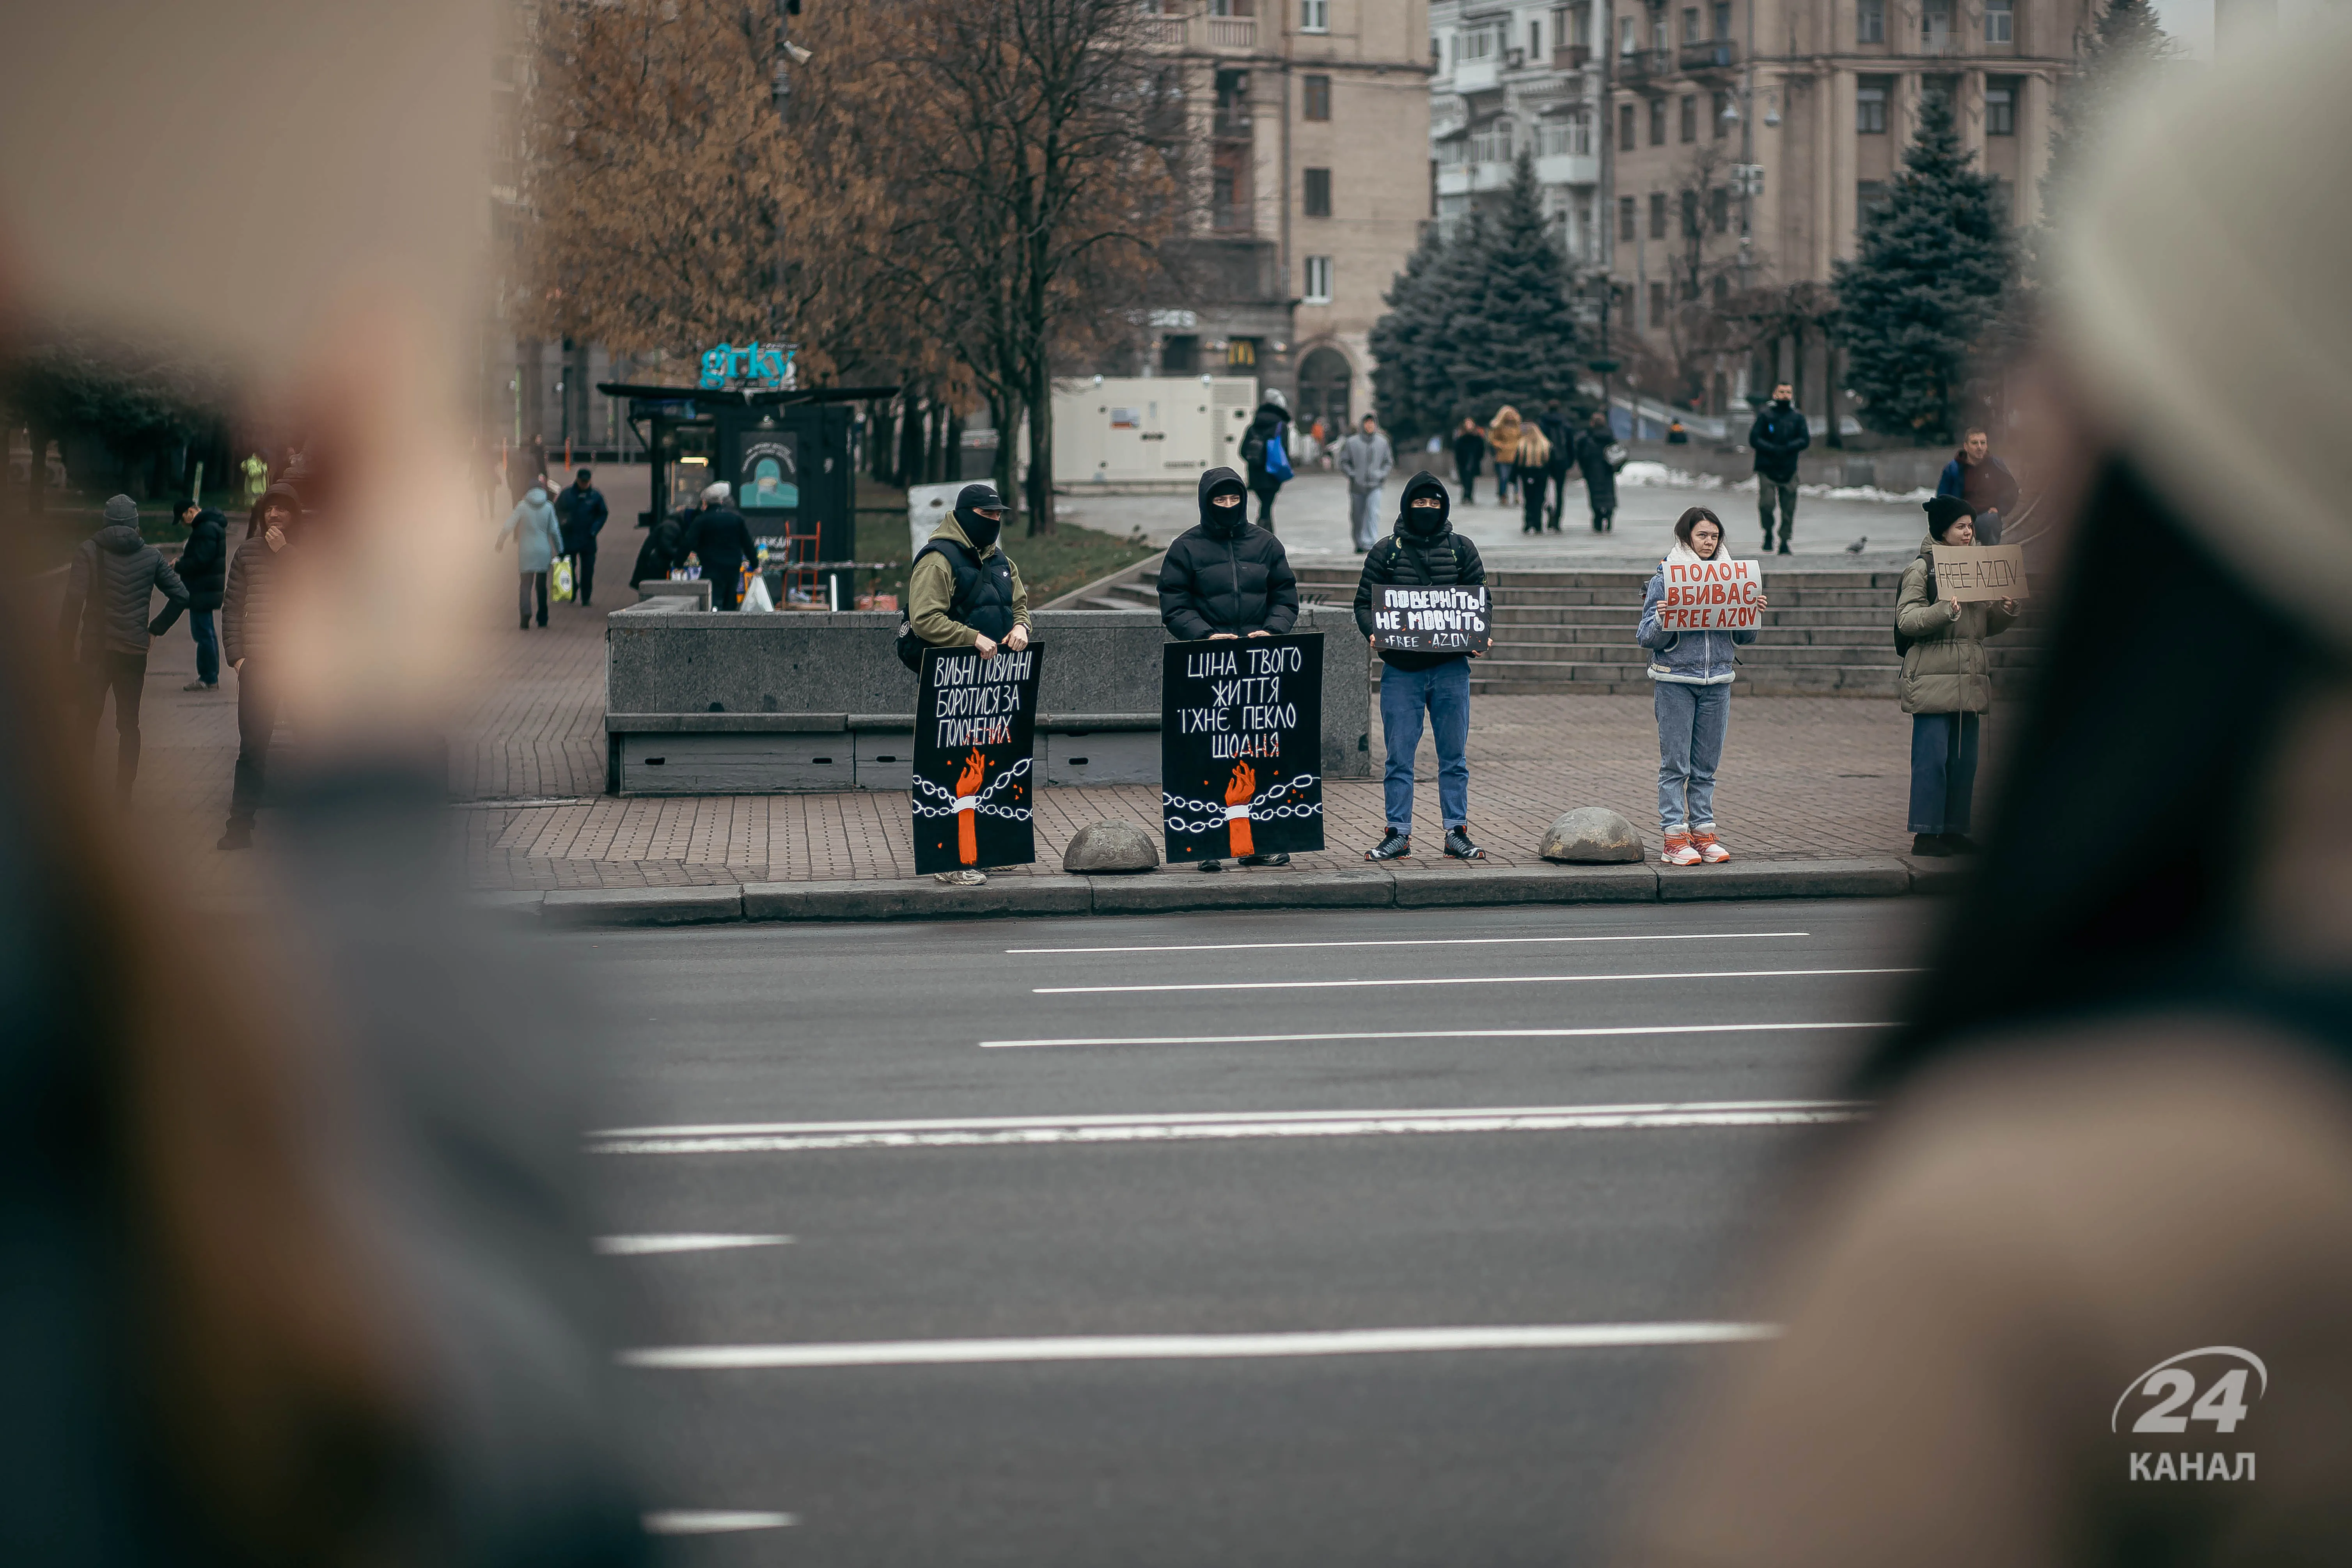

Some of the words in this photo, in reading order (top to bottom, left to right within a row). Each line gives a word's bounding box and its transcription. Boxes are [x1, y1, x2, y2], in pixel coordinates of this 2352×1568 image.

[1670, 562, 1747, 582] ПОЛОН
[1937, 562, 1972, 589] FREE
[1976, 559, 2017, 588] AZOV
[1667, 581, 1757, 606] ВБИВАЄ
[1375, 611, 1401, 630] НЕ
[1664, 608, 1712, 629] FREE
[1716, 606, 1757, 628] AZOV
[1432, 633, 1470, 648] AZOV
[934, 656, 976, 686] ВІЛЬНІ
[1188, 651, 1237, 678] ЦІНА
[1247, 646, 1301, 674] ТВОГО
[937, 686, 1000, 717] БОРОТИСЯ
[1003, 685, 1020, 712] ЗА
[1211, 677, 1279, 707] ЖИТТЯ
[937, 715, 1012, 748] ПОЛОНЕНИХ
[1177, 707, 1230, 733] ЇХНЄ
[1243, 702, 1296, 730] ПЕКЛО
[1212, 733, 1279, 758] ЩОДНЯ
